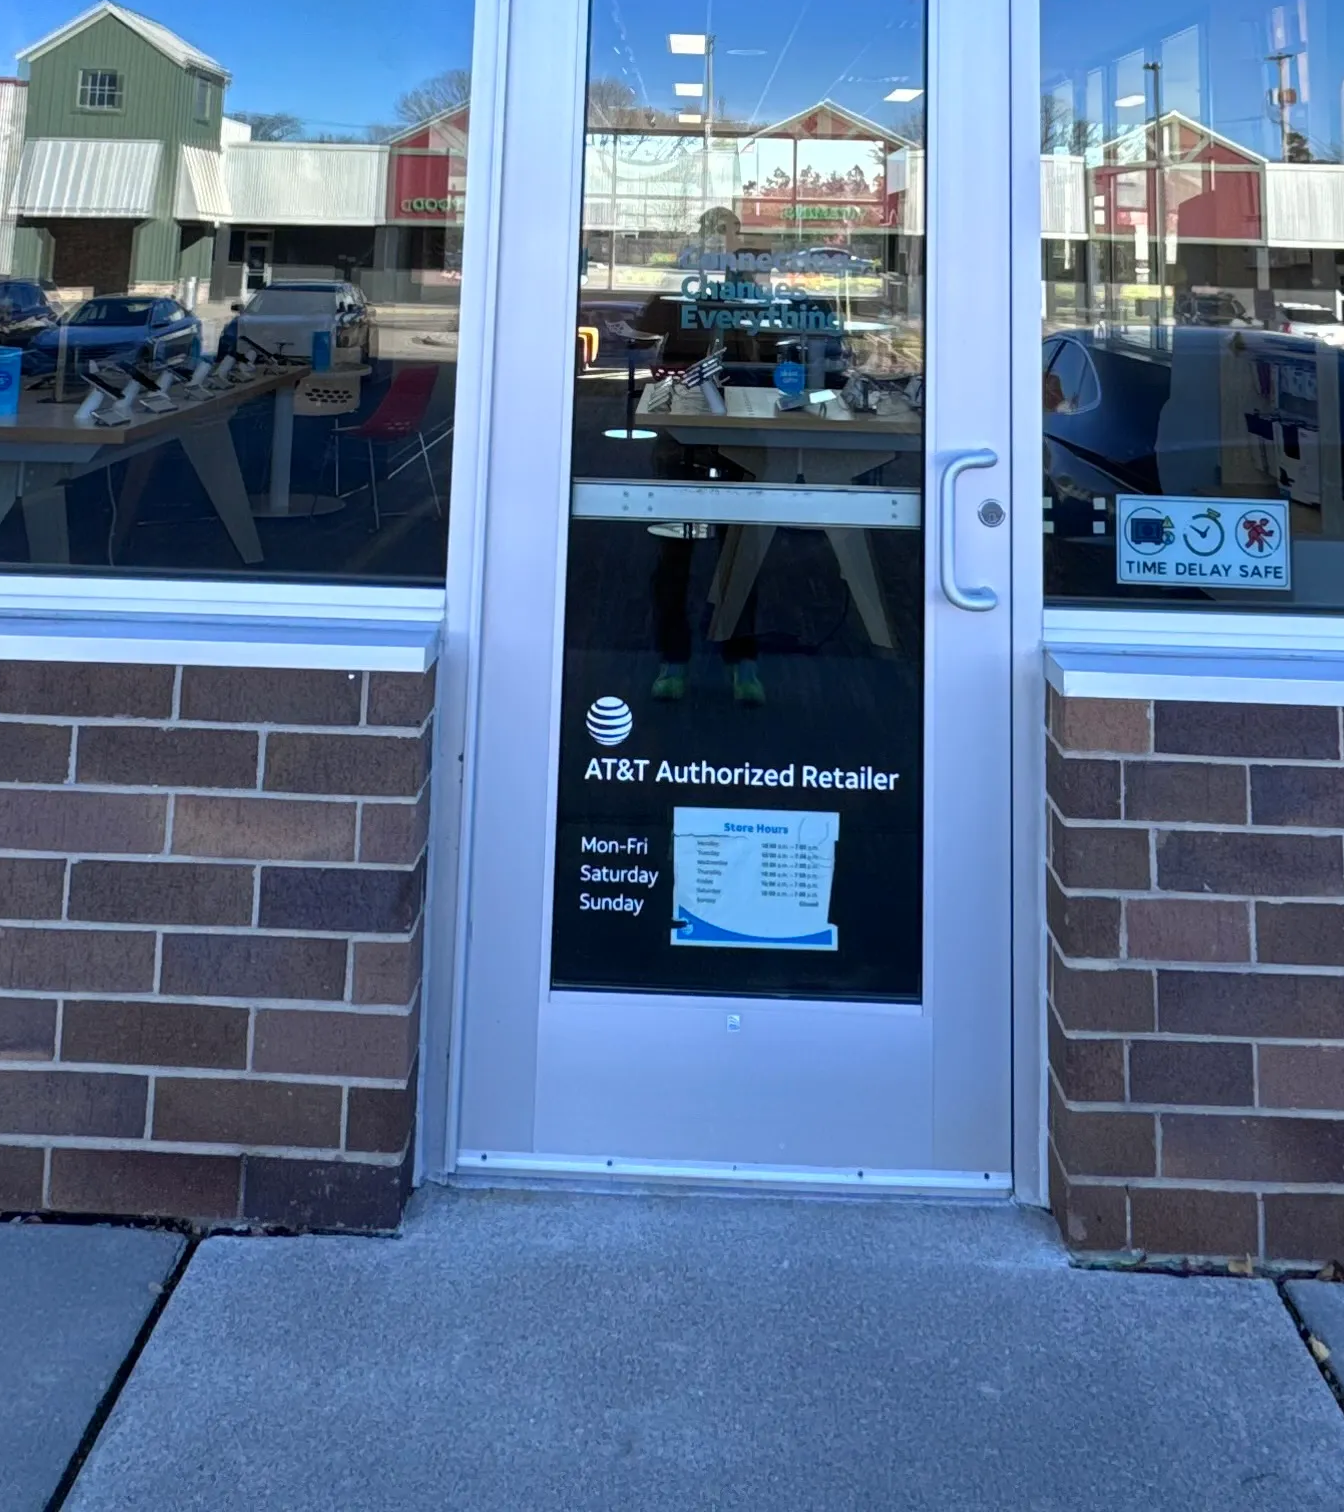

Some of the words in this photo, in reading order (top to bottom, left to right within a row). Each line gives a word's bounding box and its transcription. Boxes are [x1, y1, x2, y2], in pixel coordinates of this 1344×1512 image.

[680, 304, 843, 337] Everything
[1126, 560, 1167, 575] TIME
[1175, 562, 1232, 577] DELAY
[1239, 564, 1284, 579] SAFE
[584, 757, 651, 781] AT&T
[655, 760, 795, 787] Authorized
[801, 765, 900, 791] Retailer
[723, 822, 754, 833] Store
[756, 823, 789, 835] Hours
[581, 836, 649, 855] Mon-Fri
[579, 864, 659, 888] Saturday
[579, 893, 644, 916] Sunday
